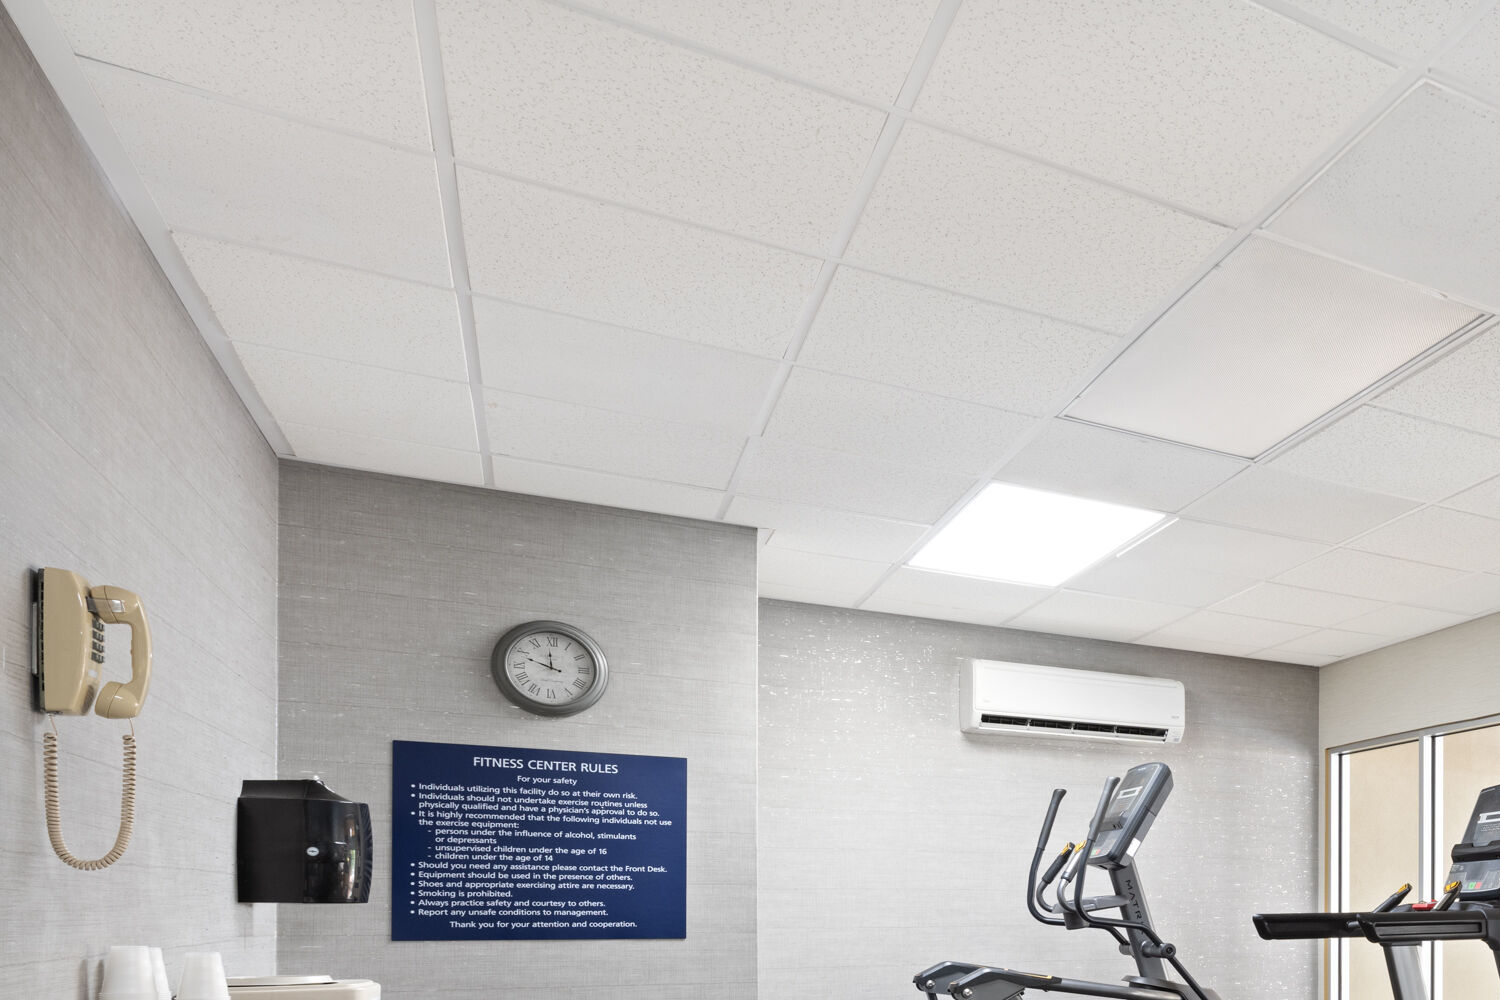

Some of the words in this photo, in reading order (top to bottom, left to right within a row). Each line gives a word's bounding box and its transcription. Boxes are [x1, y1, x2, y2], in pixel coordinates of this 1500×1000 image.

[547, 636, 558, 647] XII
[578, 667, 590, 675] III
[474, 757, 524, 769] FITNESS
[528, 760, 576, 772] CENTER
[581, 763, 618, 774] RULES
[553, 777, 577, 786] safety
[419, 783, 465, 791] Individuals
[467, 785, 500, 794] utilizing
[519, 787, 546, 796] facility
[419, 792, 464, 801] Individuals
[467, 794, 495, 802] should
[419, 801, 459, 810] physically
[548, 806, 589, 814] physician's
[591, 807, 625, 815] approval
[418, 818, 434, 826] the
[437, 811, 463, 819] highly
[562, 815, 600, 824] following
[565, 831, 595, 839] alcohol,
[447, 836, 497, 844] depressants
[552, 864, 577, 872] please
[418, 871, 465, 879] Equipment
[465, 881, 514, 889] appropriate
[516, 882, 556, 890] exercising
[418, 890, 456, 898] Smoking
[418, 899, 449, 907] Always
[486, 899, 512, 908] safety
[418, 909, 448, 917] Report
